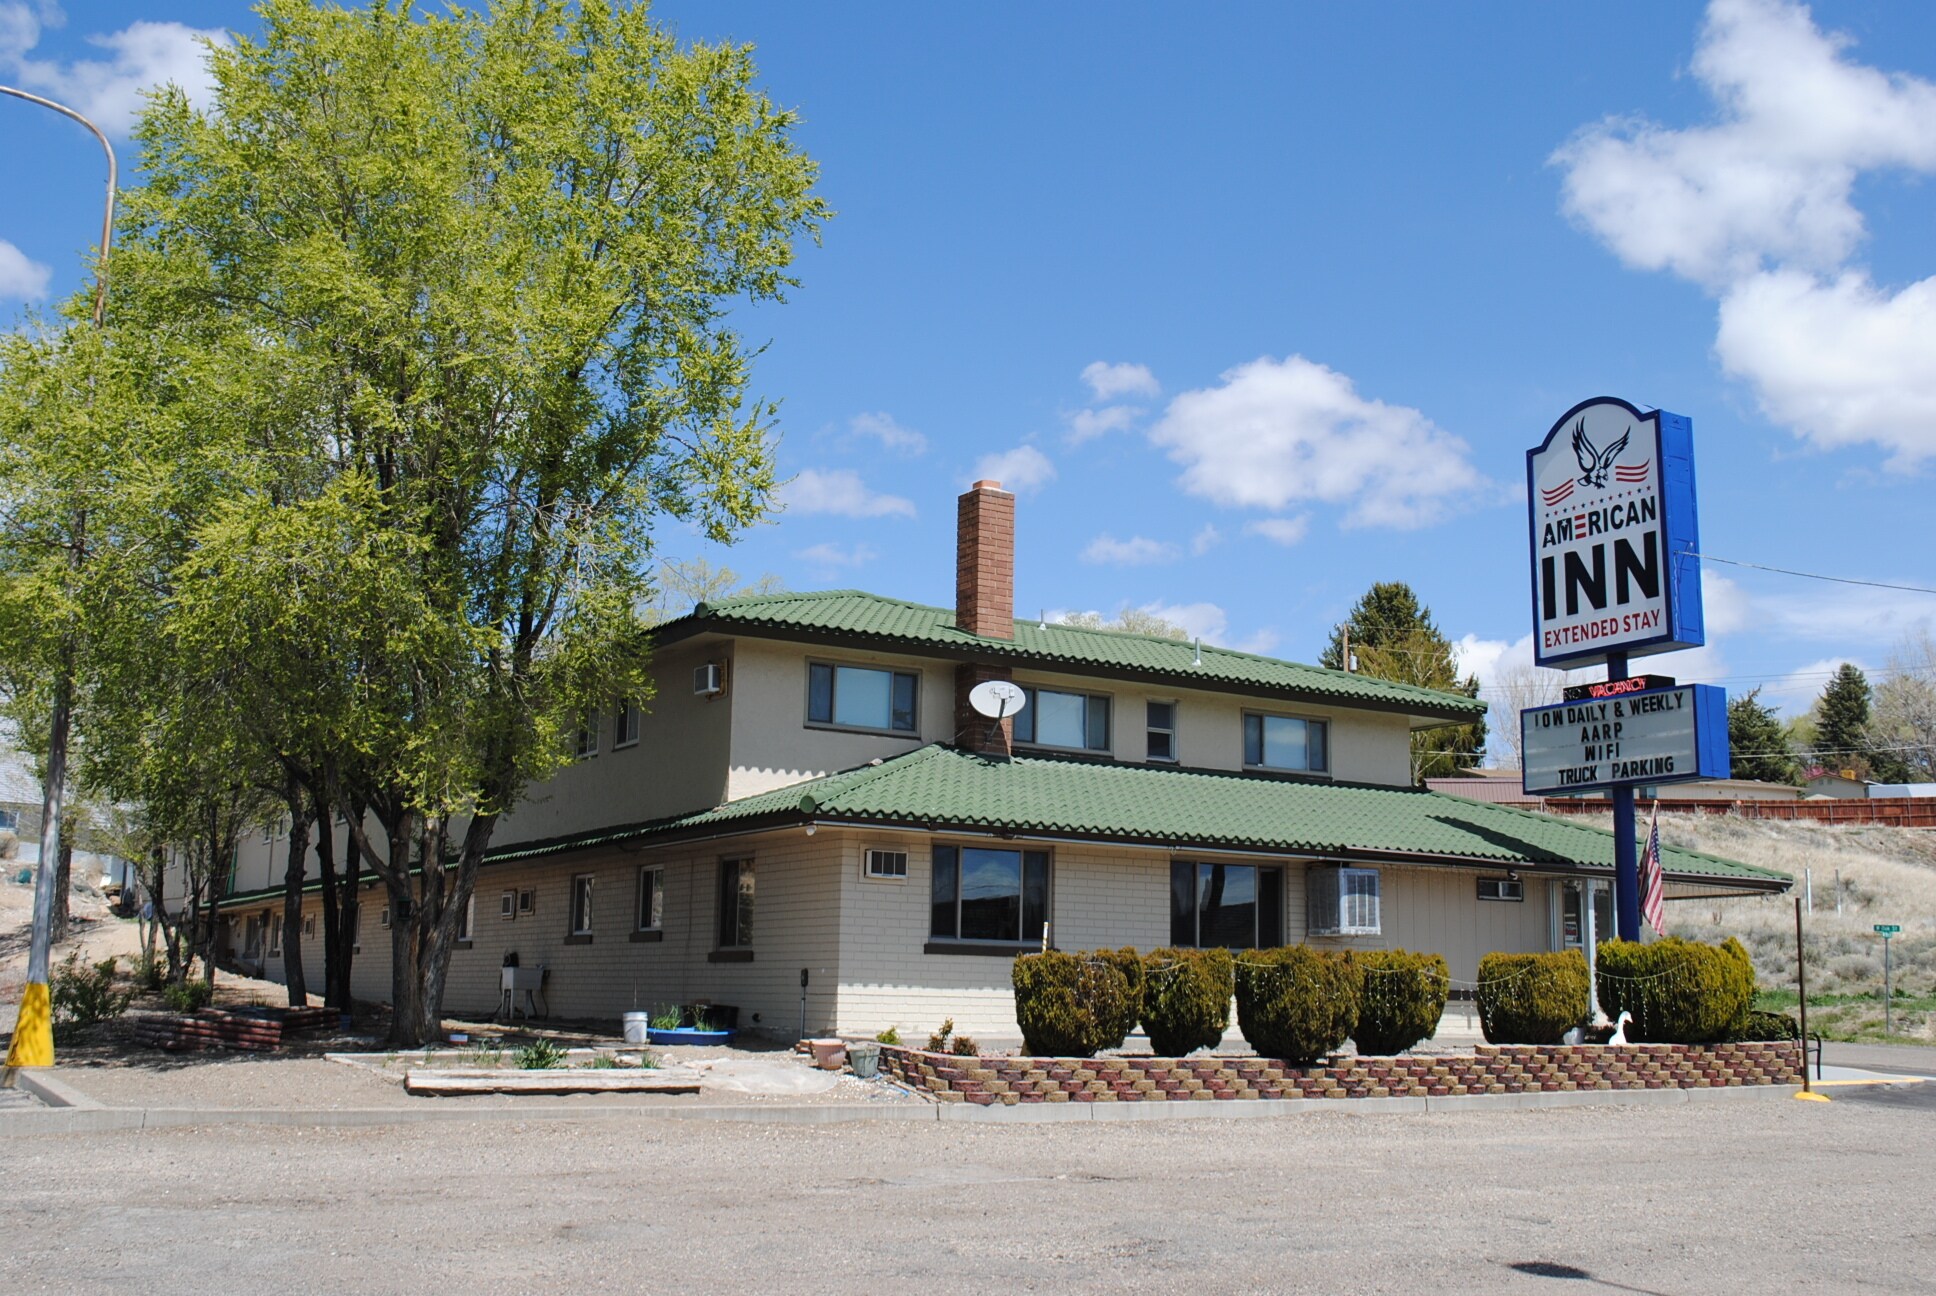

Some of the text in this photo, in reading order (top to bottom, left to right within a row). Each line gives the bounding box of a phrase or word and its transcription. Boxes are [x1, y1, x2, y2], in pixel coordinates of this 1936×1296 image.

[1542, 495, 1656, 548] AMERICAN
[1542, 531, 1660, 621] INN
[1545, 609, 1660, 648] EXTENDED STAY
[1588, 678, 1646, 698] VACANCY
[1567, 704, 1607, 724] DAILY
[1614, 701, 1625, 718] &
[1630, 692, 1683, 715] WEEKLY
[1580, 722, 1623, 743] AARP
[1584, 742, 1620, 762] WIFI
[1558, 756, 1674, 786] TRUCK PARKING
